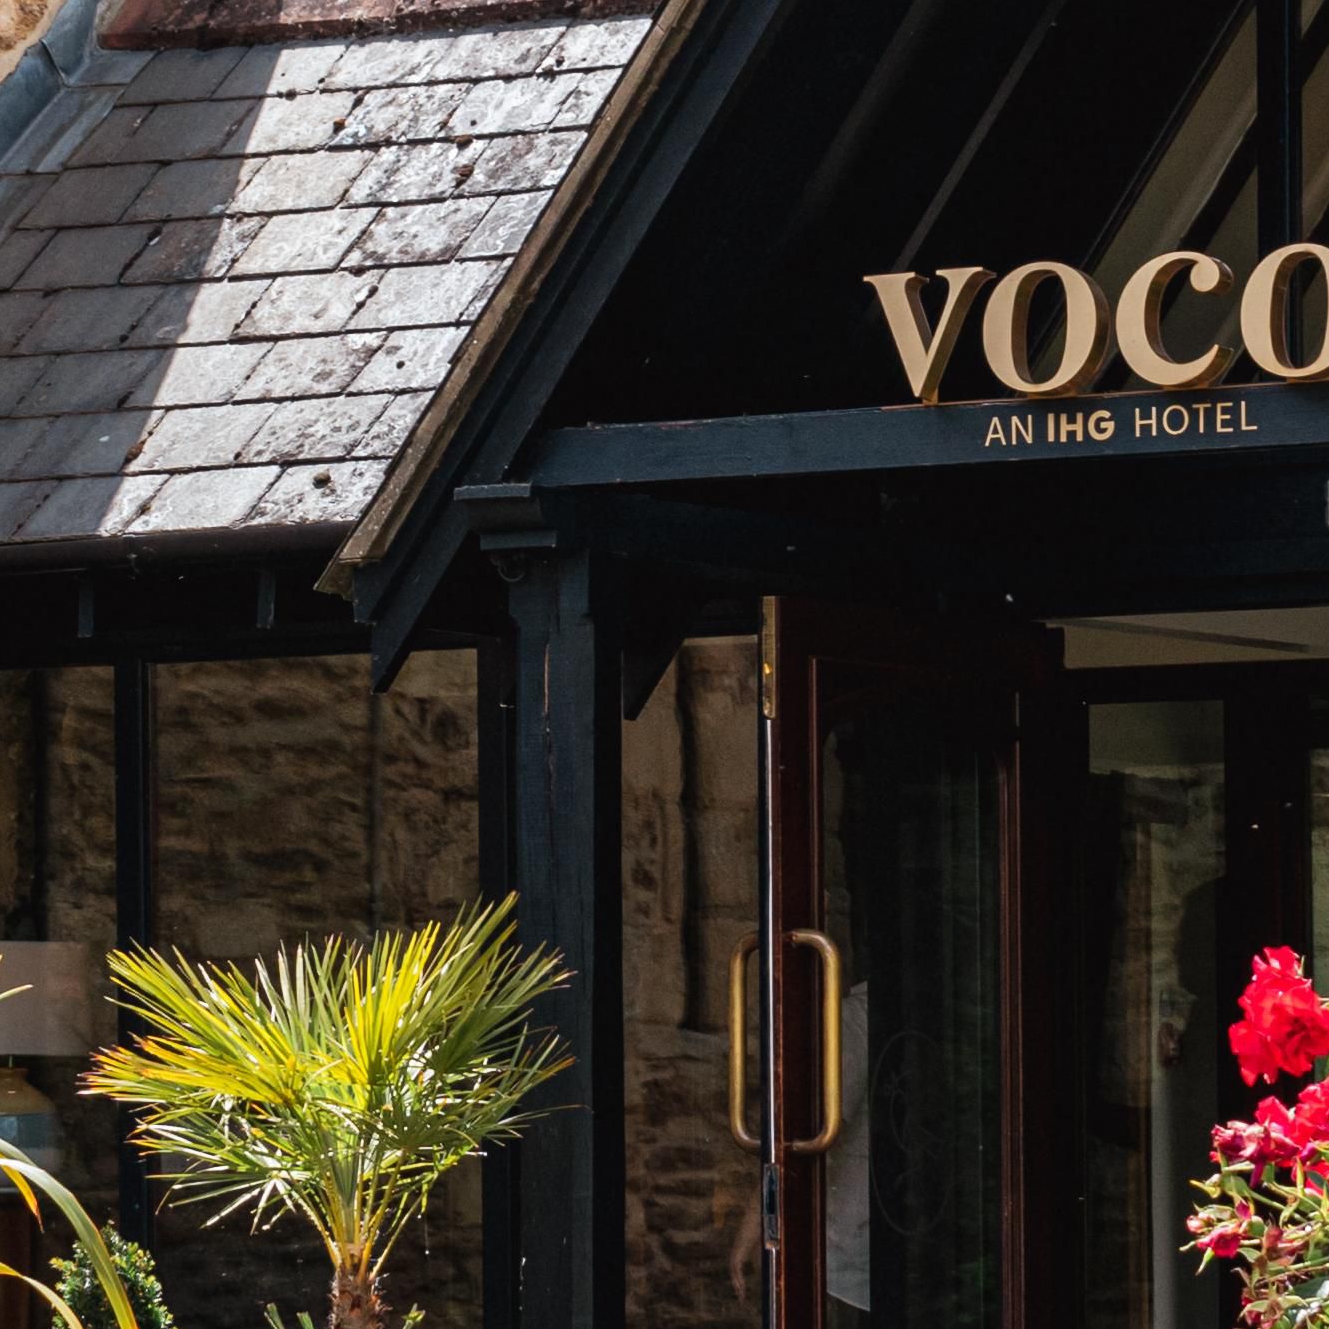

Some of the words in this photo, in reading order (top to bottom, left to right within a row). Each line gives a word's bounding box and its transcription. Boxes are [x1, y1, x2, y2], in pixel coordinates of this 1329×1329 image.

[984, 414, 1033, 447] AN
[1047, 409, 1115, 443] IHG
[1134, 400, 1258, 438] HOTEL
